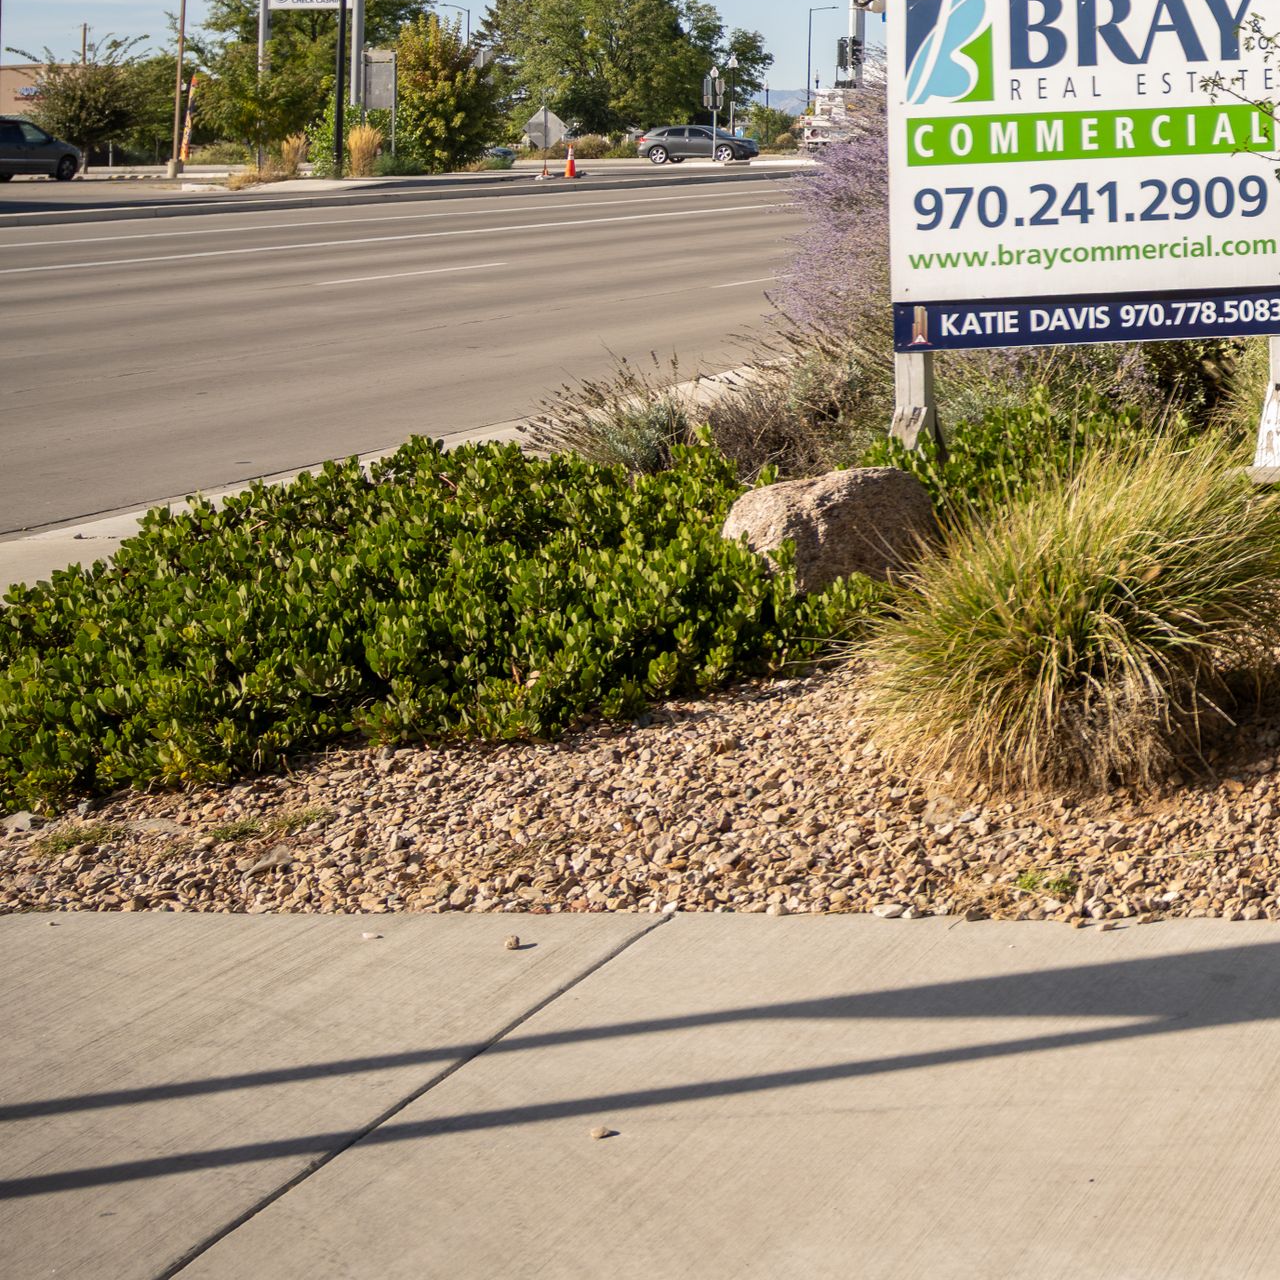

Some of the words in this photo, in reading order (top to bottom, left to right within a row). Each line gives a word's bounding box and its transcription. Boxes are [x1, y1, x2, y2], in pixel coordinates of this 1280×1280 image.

[1010, 75, 1102, 100] REAL
[1137, 67, 1274, 95] ESTATE
[913, 111, 1269, 158] COMMERCIAL
[913, 175, 1268, 231] 970.241.2909
[909, 235, 1277, 270] www.braycommercial.com
[940, 311, 1019, 336] KATIE
[1030, 306, 1110, 332] DAVIS
